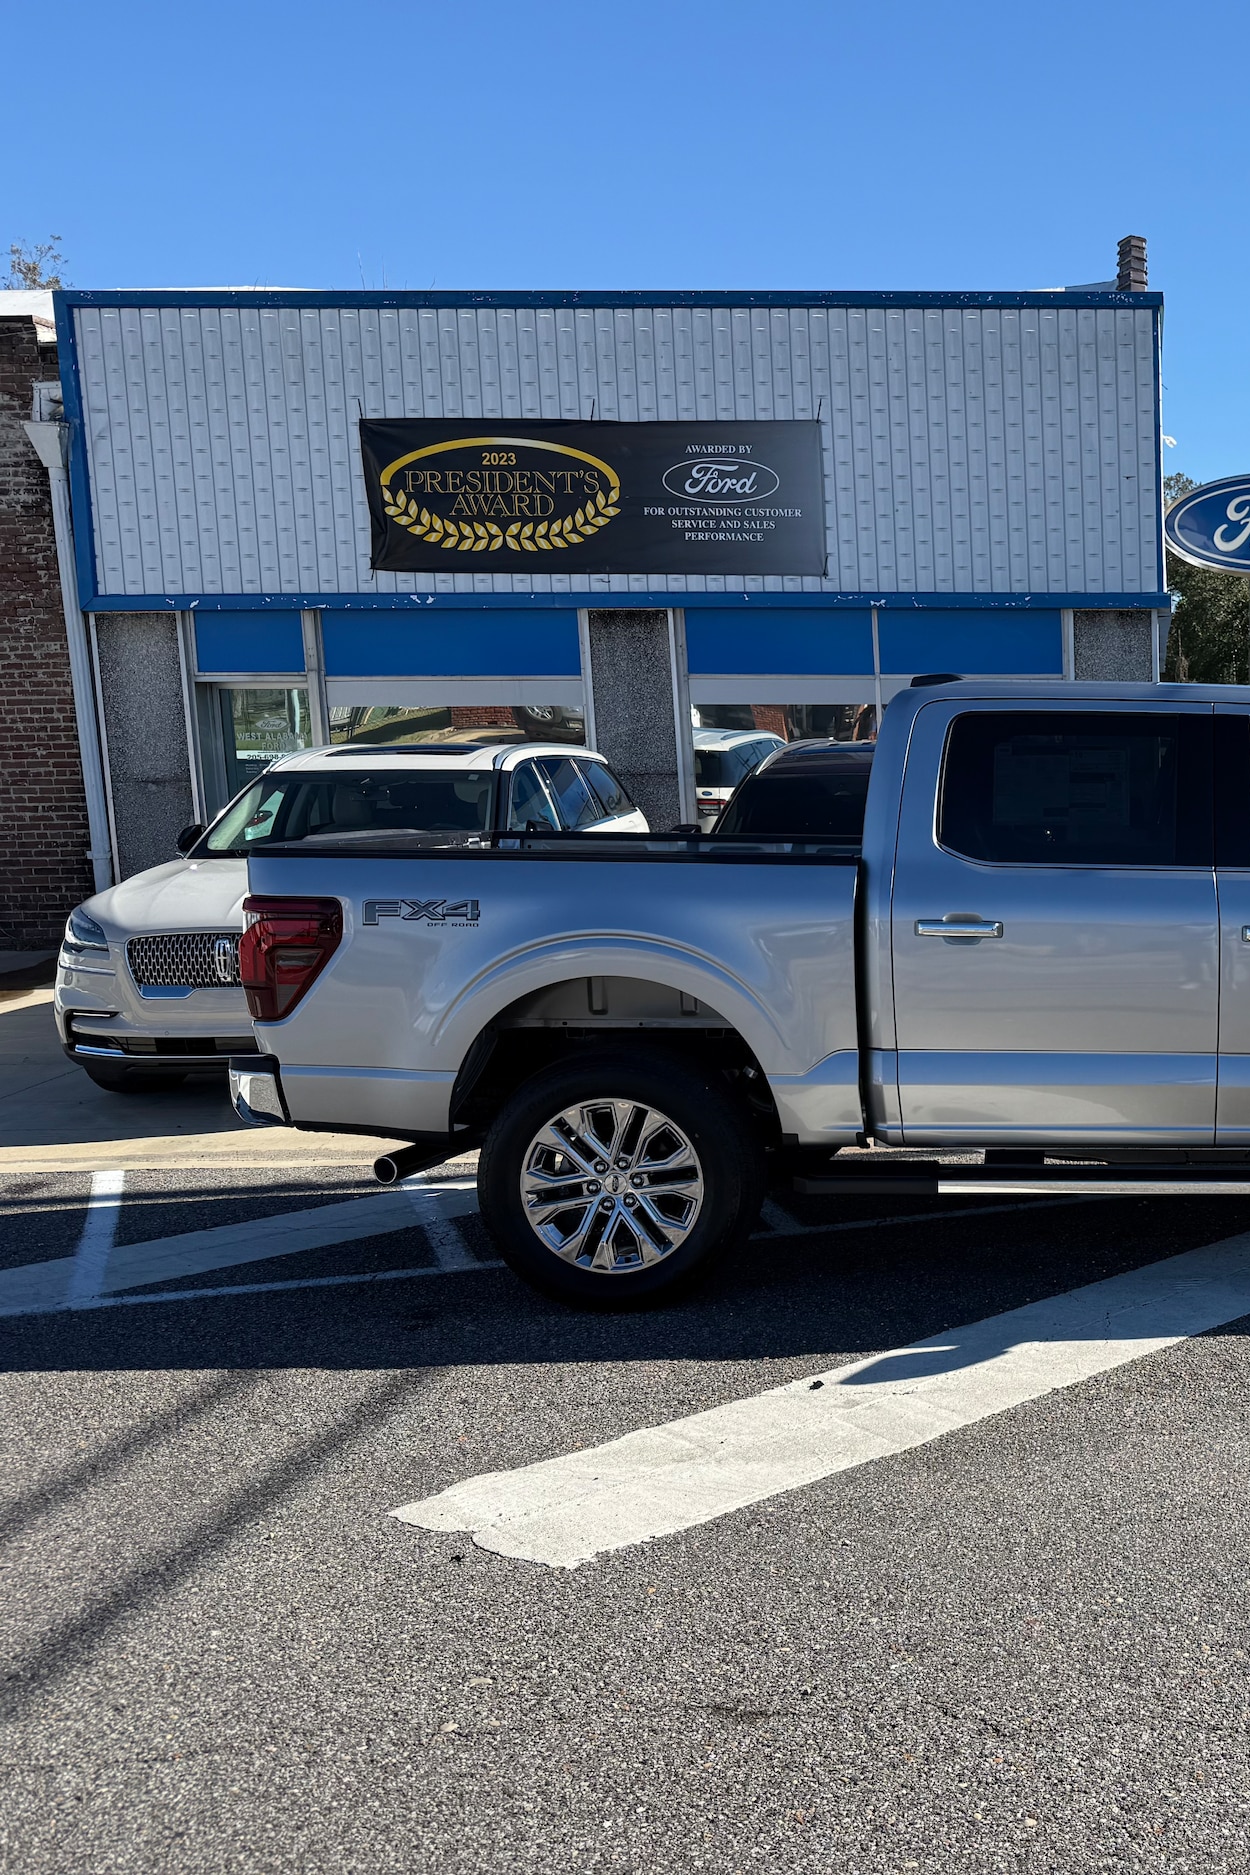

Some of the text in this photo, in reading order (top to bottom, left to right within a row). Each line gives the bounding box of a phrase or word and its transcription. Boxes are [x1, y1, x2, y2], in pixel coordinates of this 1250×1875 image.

[685, 444, 753, 454] AWARDED BY
[481, 452, 517, 466] 2023
[404, 469, 600, 494] PRESIDENT'S
[684, 463, 758, 494] Ford
[449, 493, 555, 517] AWARD
[643, 506, 803, 518] FOR OUTSTANDING CUSTOMER
[671, 519, 776, 530] SERVICE AND SALES
[684, 532, 764, 542] PERFORMANCE
[260, 720, 284, 729] Ford
[236, 732, 262, 741] WEST
[261, 742, 287, 751] FORD
[362, 898, 481, 926] FX4
